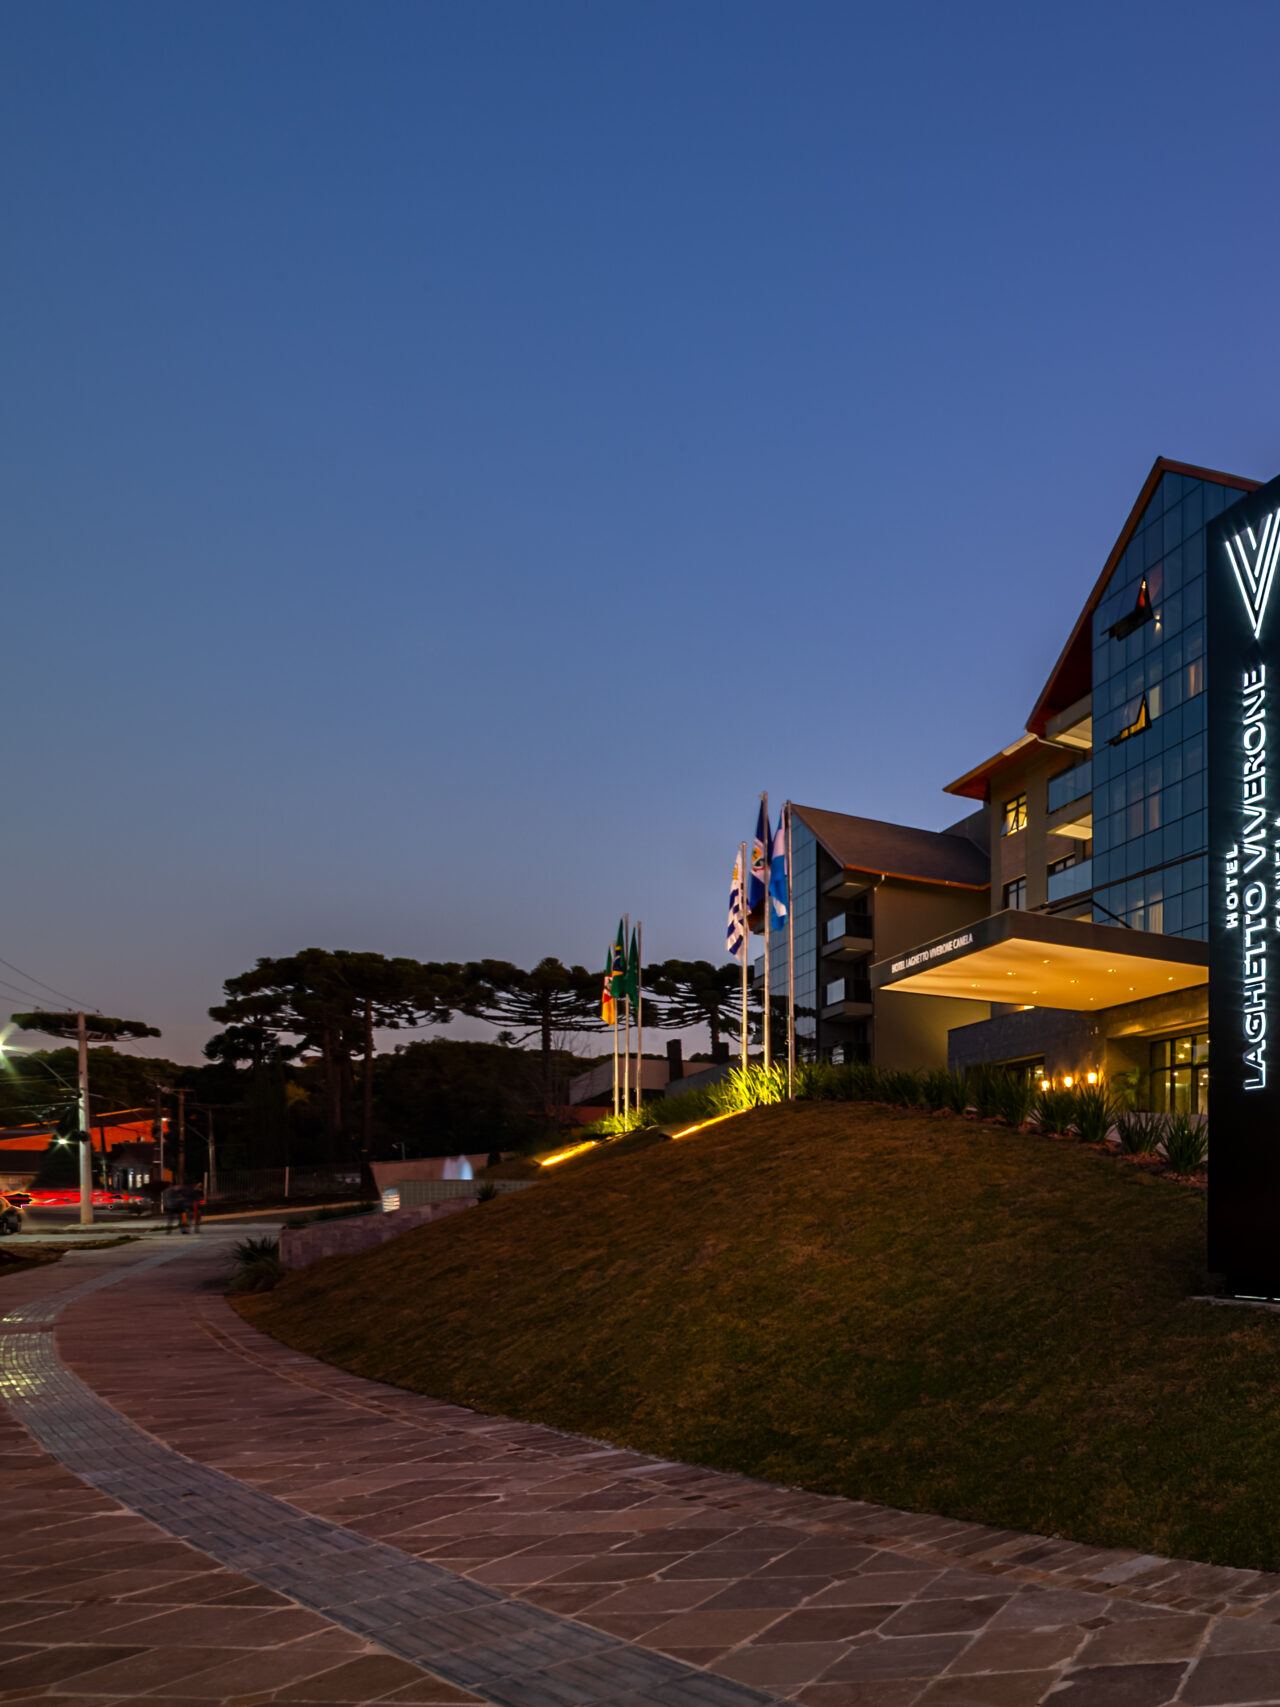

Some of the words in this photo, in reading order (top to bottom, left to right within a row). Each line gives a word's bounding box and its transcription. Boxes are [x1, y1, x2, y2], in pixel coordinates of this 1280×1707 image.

[1242, 664, 1267, 875] VIVERONE
[906, 951, 929, 968] LAGHETTO
[929, 941, 953, 959] VIVERONE
[953, 933, 973, 949] CANELA
[1225, 844, 1239, 930] HOTEL
[1243, 881, 1267, 1090] LAGHETTO
